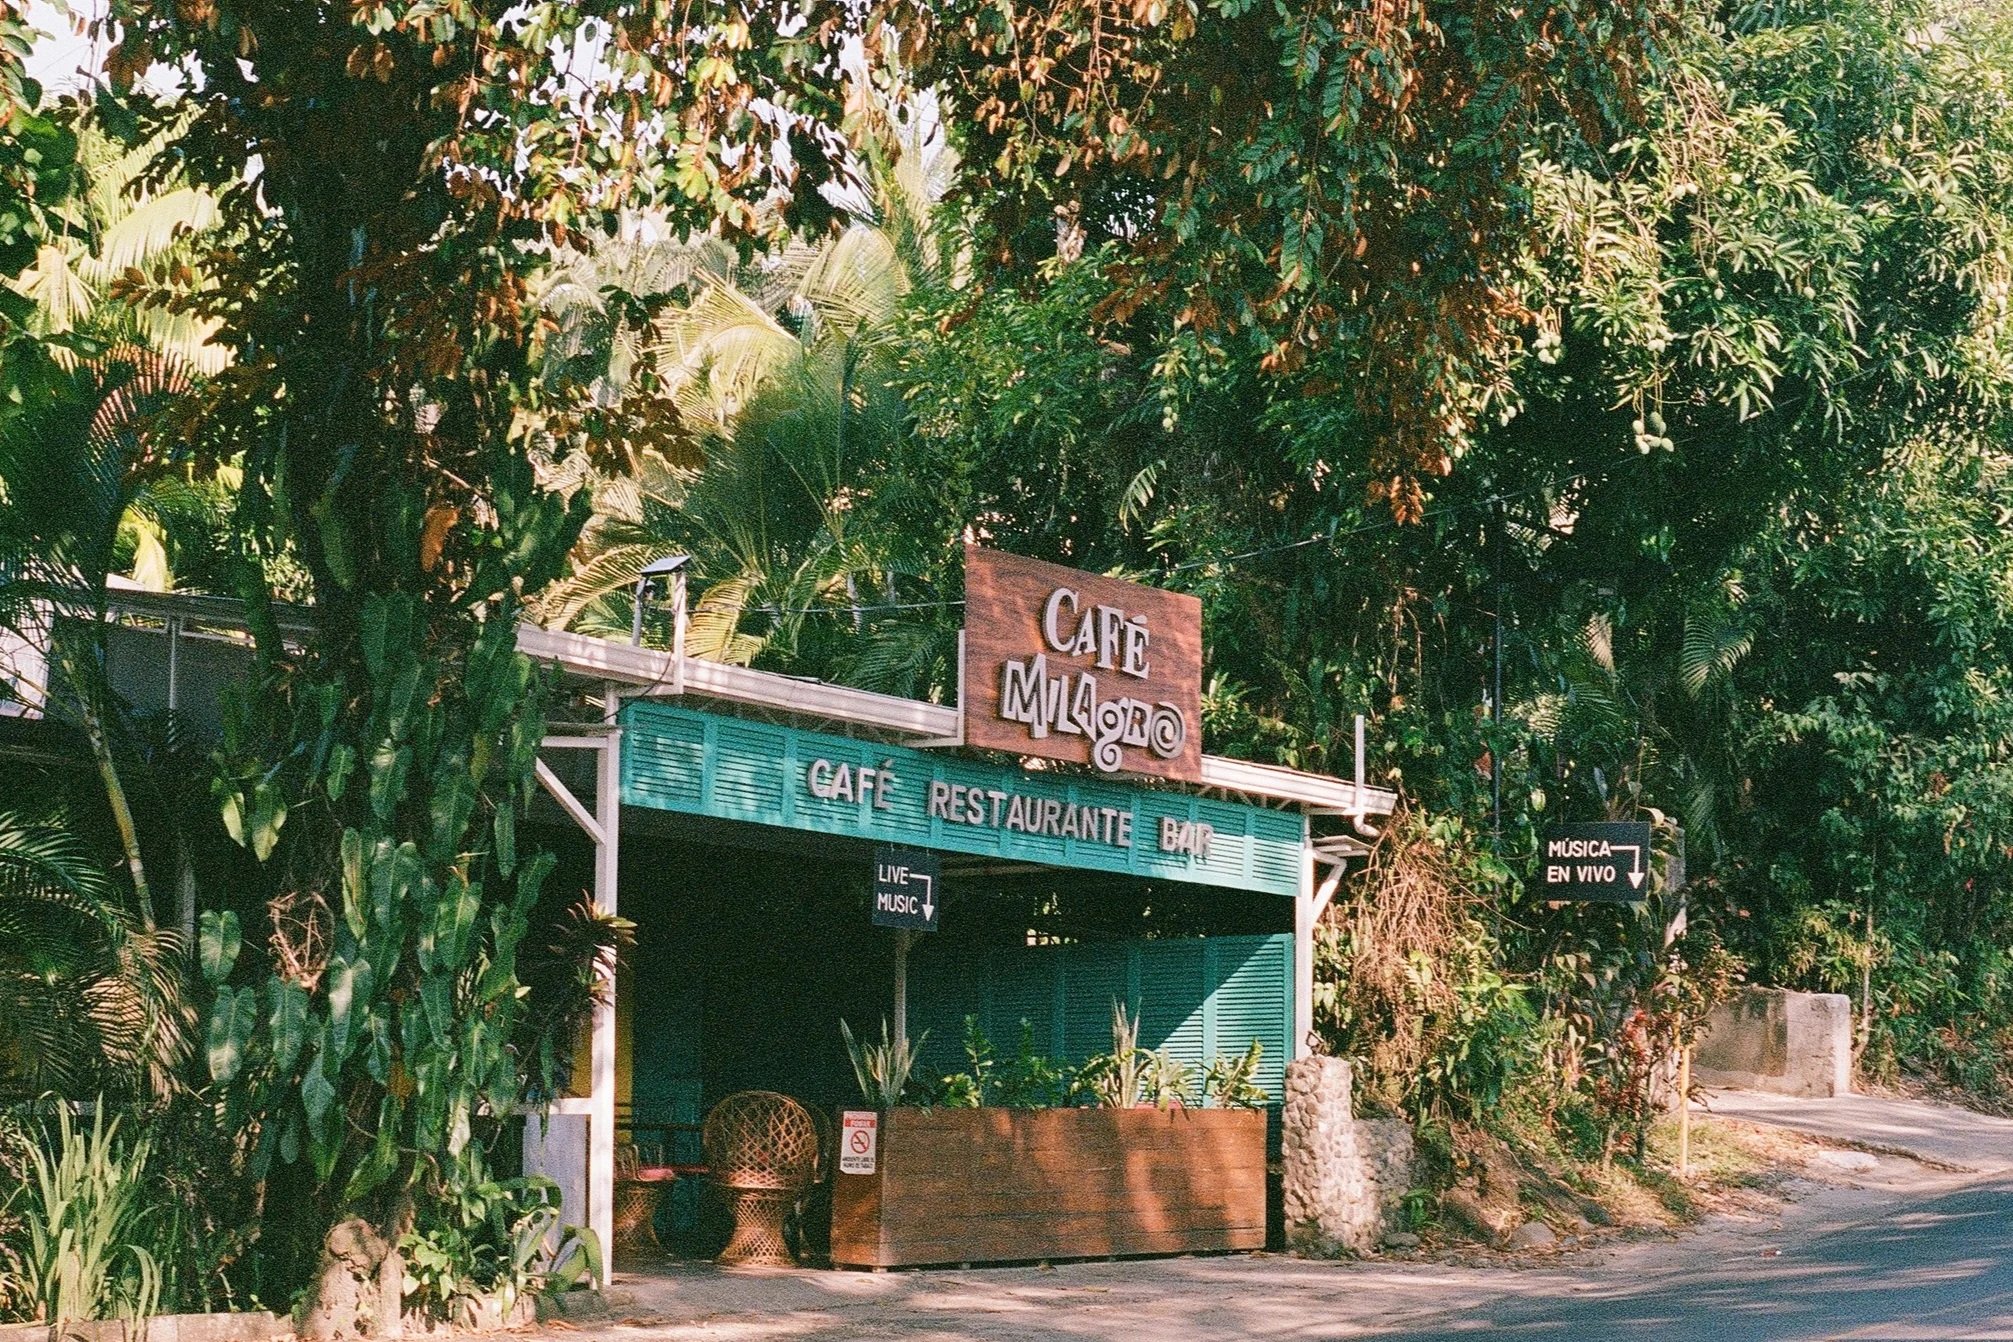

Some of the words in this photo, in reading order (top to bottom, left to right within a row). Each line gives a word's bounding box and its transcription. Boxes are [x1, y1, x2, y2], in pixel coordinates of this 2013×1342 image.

[1043, 587, 1150, 680] CAFÉ
[808, 758, 895, 810] CAFÉ
[928, 779, 1134, 847] RESTAURANTE
[1159, 816, 1216, 857] BAR
[1547, 837, 1612, 858] MÚSICA
[878, 863, 909, 885] LIVE
[1546, 865, 1571, 883] EN
[1576, 865, 1616, 883] VIVO
[877, 892, 919, 915] MUSIC
